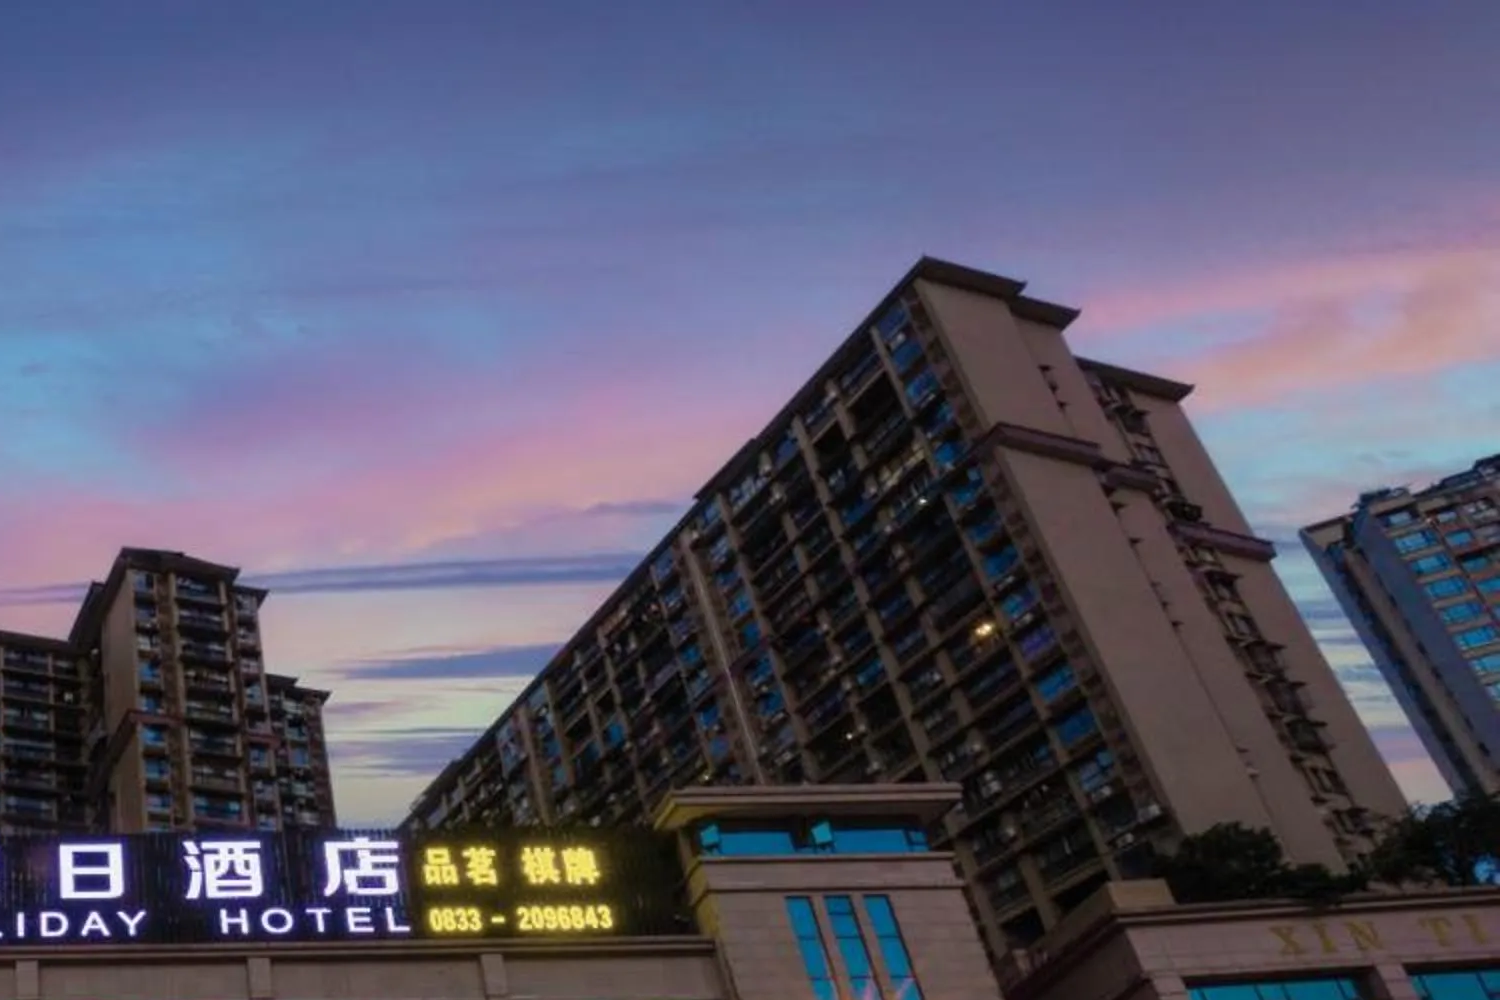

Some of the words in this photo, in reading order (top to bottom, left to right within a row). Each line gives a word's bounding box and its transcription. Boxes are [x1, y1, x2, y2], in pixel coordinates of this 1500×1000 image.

[423, 847, 498, 885] 品茗
[521, 847, 600, 885] 棋牌
[219, 907, 411, 934] HOTEL
[429, 907, 483, 932] 0833
[517, 905, 614, 931] 2096843
[1269, 918, 1384, 956] XIN
